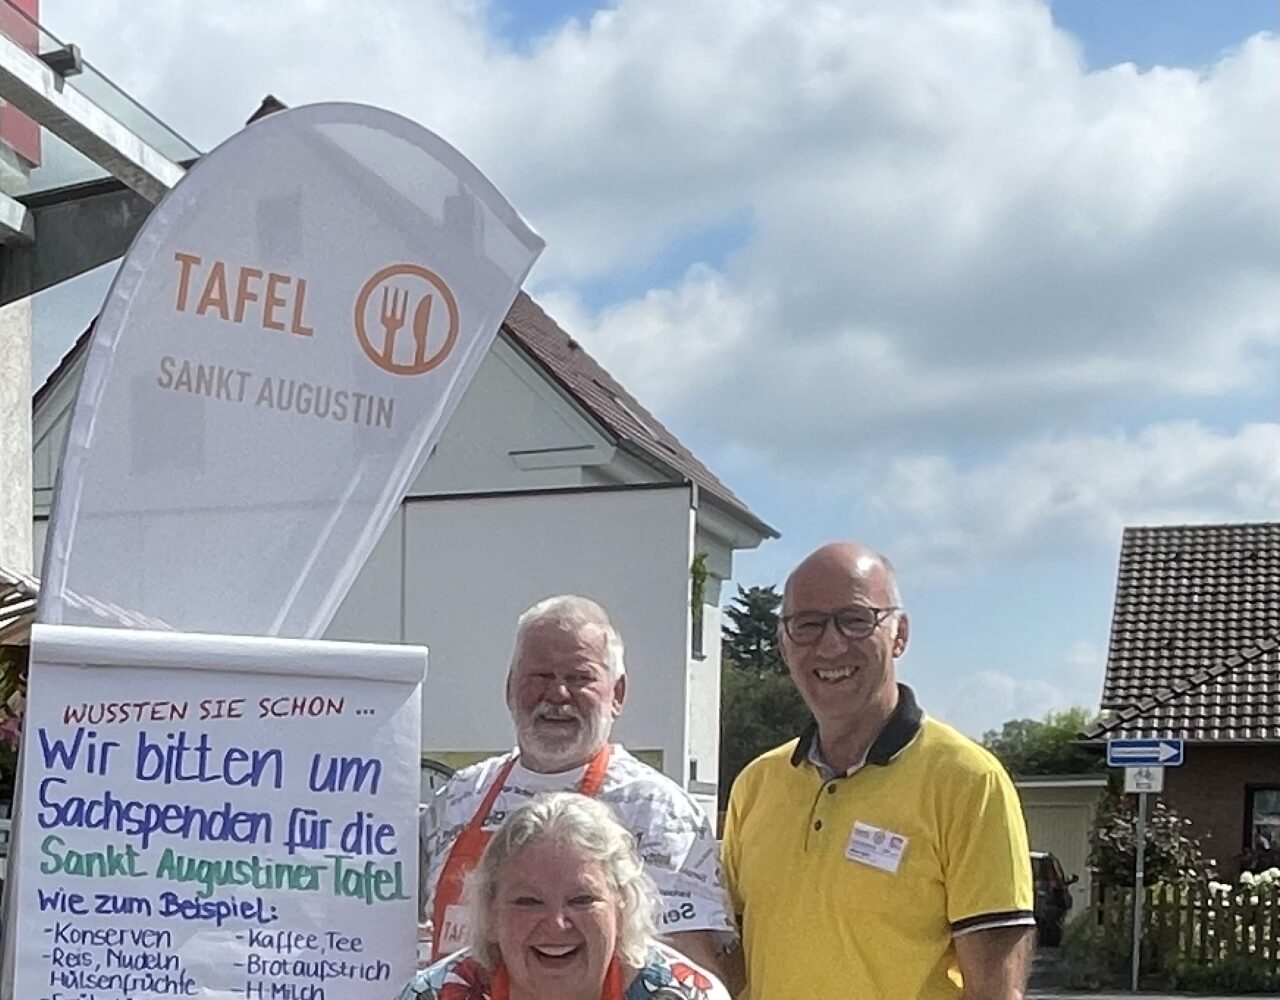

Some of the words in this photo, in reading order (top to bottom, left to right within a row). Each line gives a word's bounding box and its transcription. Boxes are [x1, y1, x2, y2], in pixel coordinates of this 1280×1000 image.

[174, 252, 314, 337] TAFEL
[157, 355, 252, 403] SANKT
[255, 376, 395, 429] AUGUSTIN
[63, 701, 188, 724] WUSSTEN
[200, 698, 245, 720] SIE
[258, 696, 345, 718] SCHON
[38, 727, 120, 776] Wir
[136, 731, 283, 789] bitten
[309, 753, 382, 795] um
[38, 777, 271, 849] Sachspenden
[283, 806, 332, 855] für
[340, 811, 398, 856] die
[40, 834, 148, 878] Sankt
[156, 847, 327, 898] Augustiner
[324, 854, 412, 905] Tafel
[95, 892, 151, 916] zum
[159, 891, 280, 926] Beispiel:
[50, 968, 199, 996] Hülsenfrüchte
